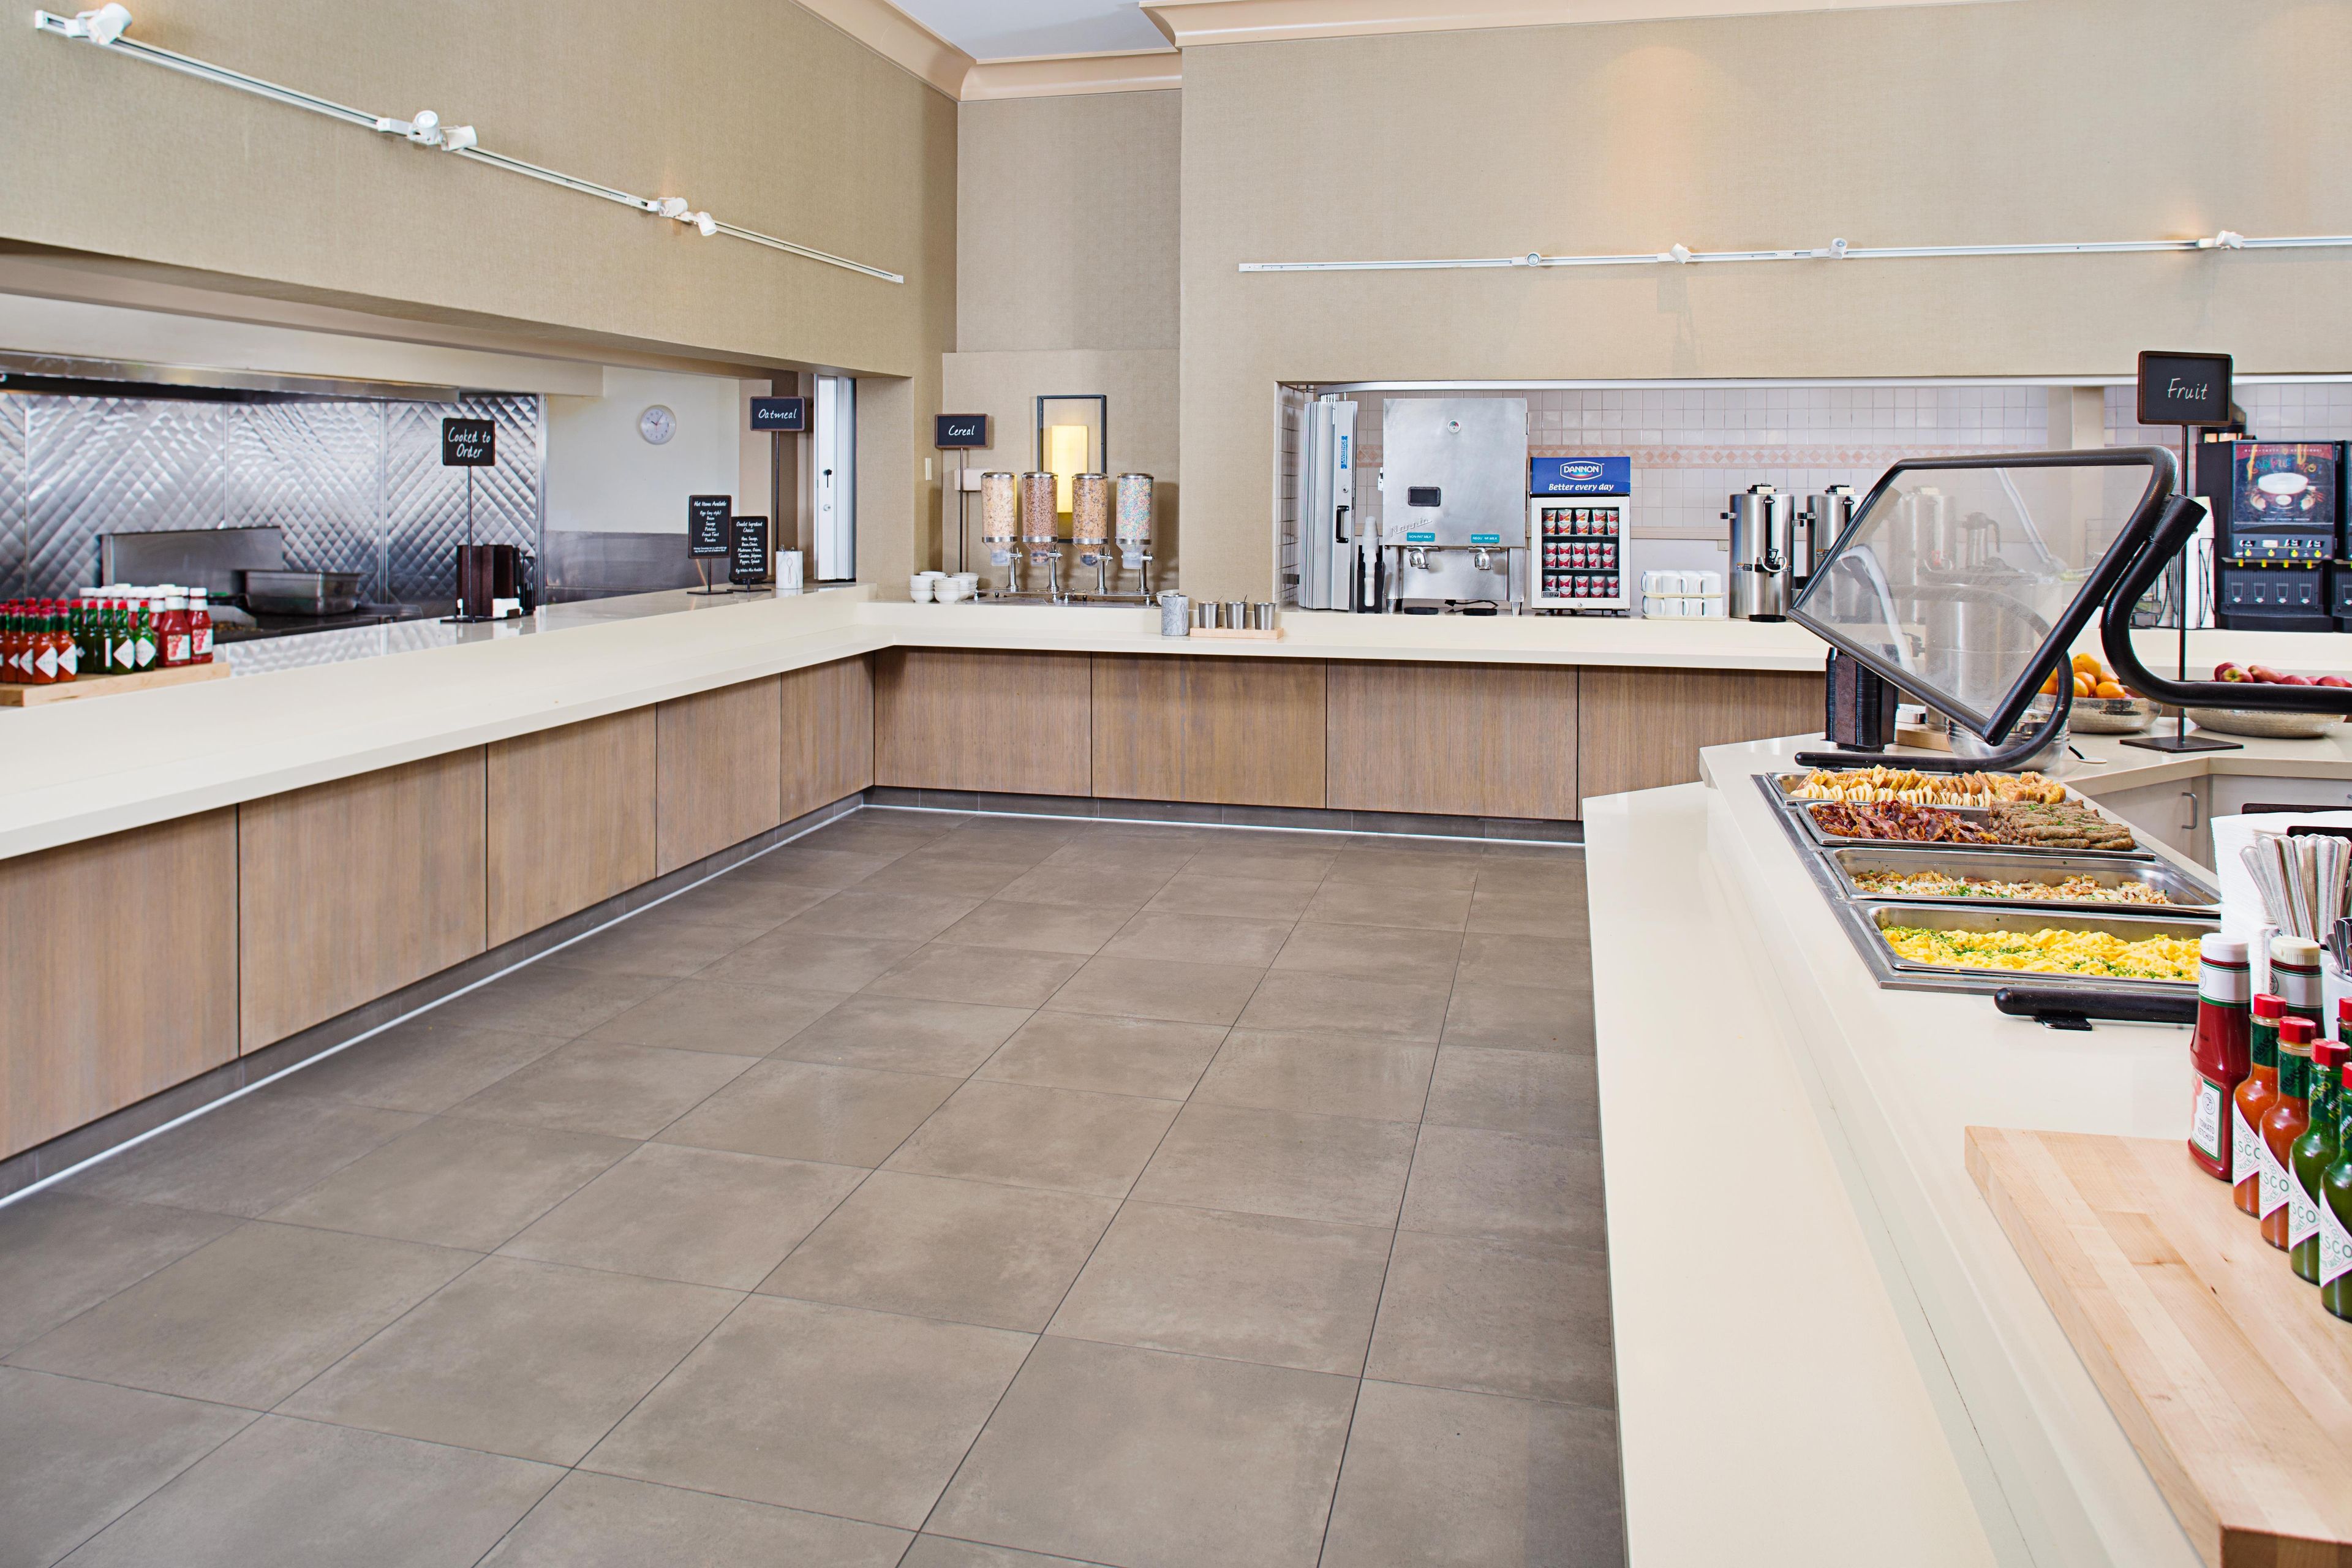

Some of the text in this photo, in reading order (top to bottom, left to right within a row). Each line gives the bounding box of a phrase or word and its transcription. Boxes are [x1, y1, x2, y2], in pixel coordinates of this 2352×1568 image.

[2168, 378, 2209, 401] Fruit
[758, 409, 797, 419] Oatmeal
[448, 426, 491, 443] Cooked to
[948, 425, 975, 436] Cereal
[456, 443, 483, 459] Order
[1564, 465, 1600, 473] DANNON
[1575, 483, 1597, 492] every
[1599, 483, 1615, 492] day
[2199, 1118, 2215, 1134] TOMATO
[2198, 1127, 2215, 1142] KETCHUP
